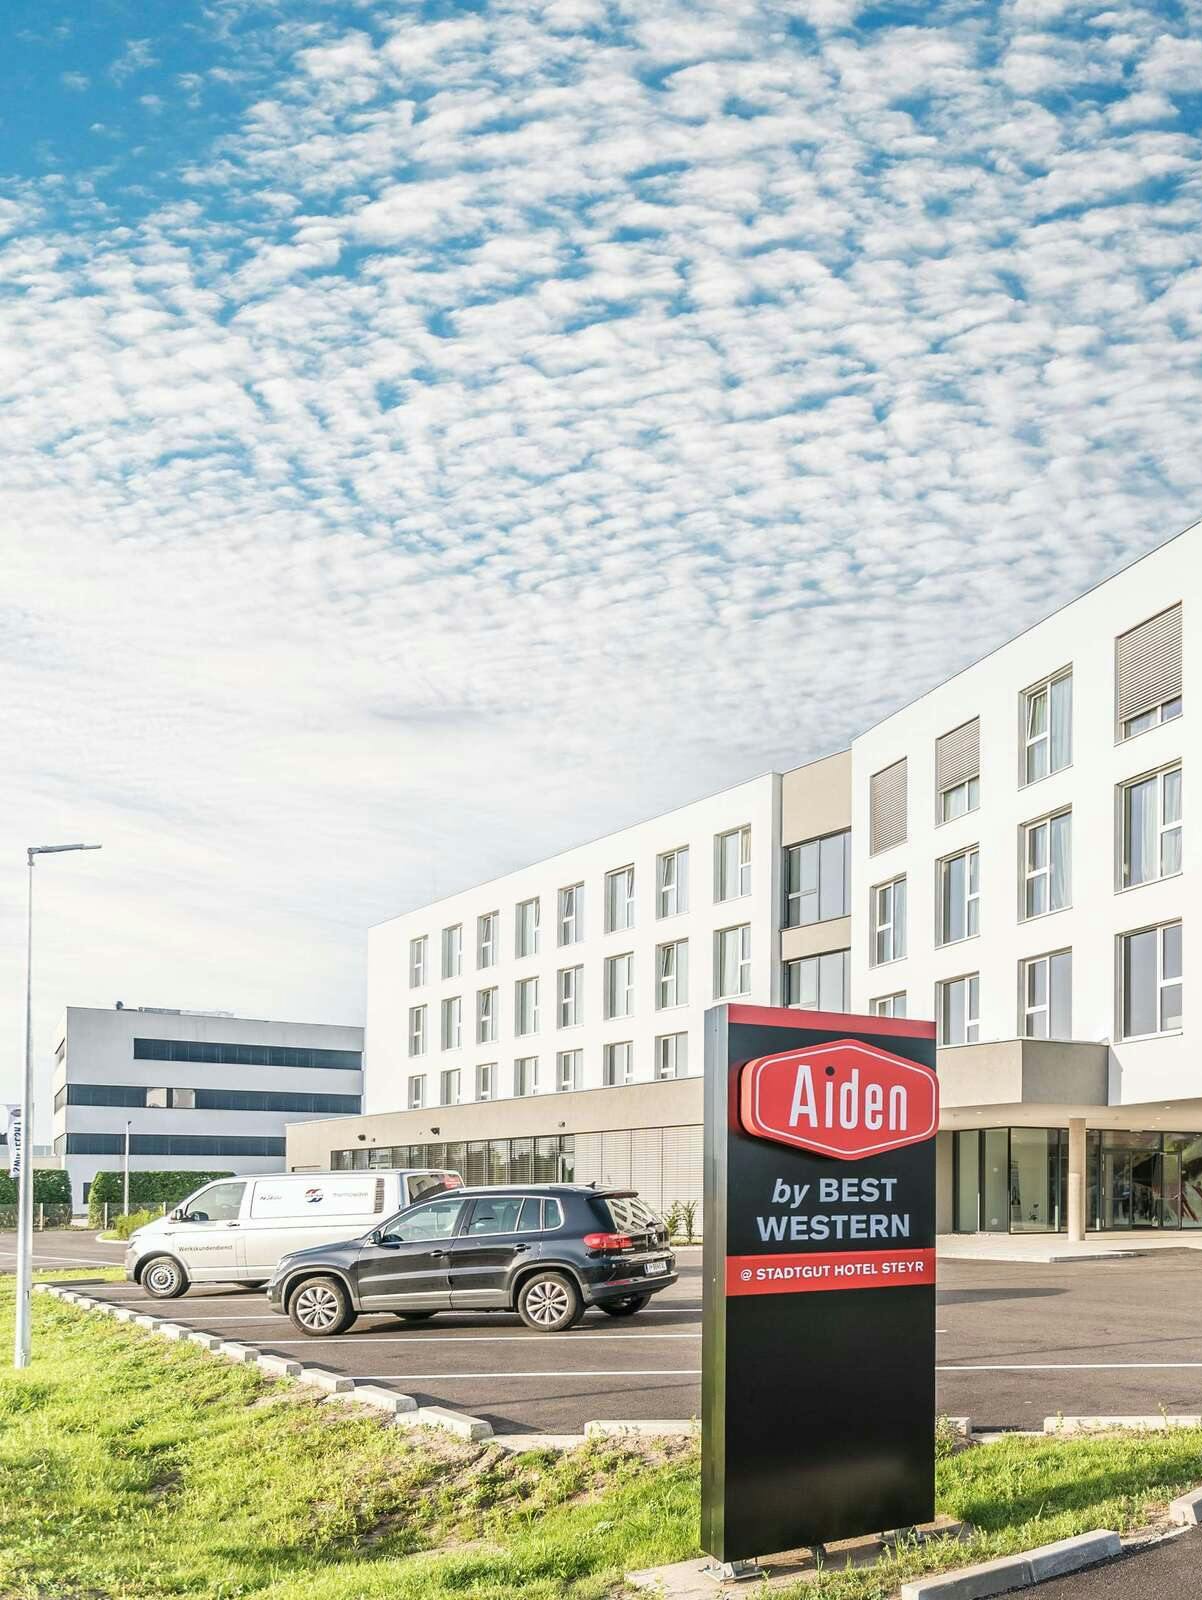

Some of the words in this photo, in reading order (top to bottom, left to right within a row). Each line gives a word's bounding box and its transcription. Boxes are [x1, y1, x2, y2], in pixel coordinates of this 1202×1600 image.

[789, 1064, 907, 1131] Aiden
[771, 1178, 811, 1209] by
[819, 1177, 898, 1203] BEST
[756, 1213, 910, 1242] WESTERN
[740, 1269, 752, 1281] @
[756, 1265, 831, 1280] STADTGUT
[834, 1263, 878, 1277] HOTEL
[881, 1261, 924, 1274] STEYR
